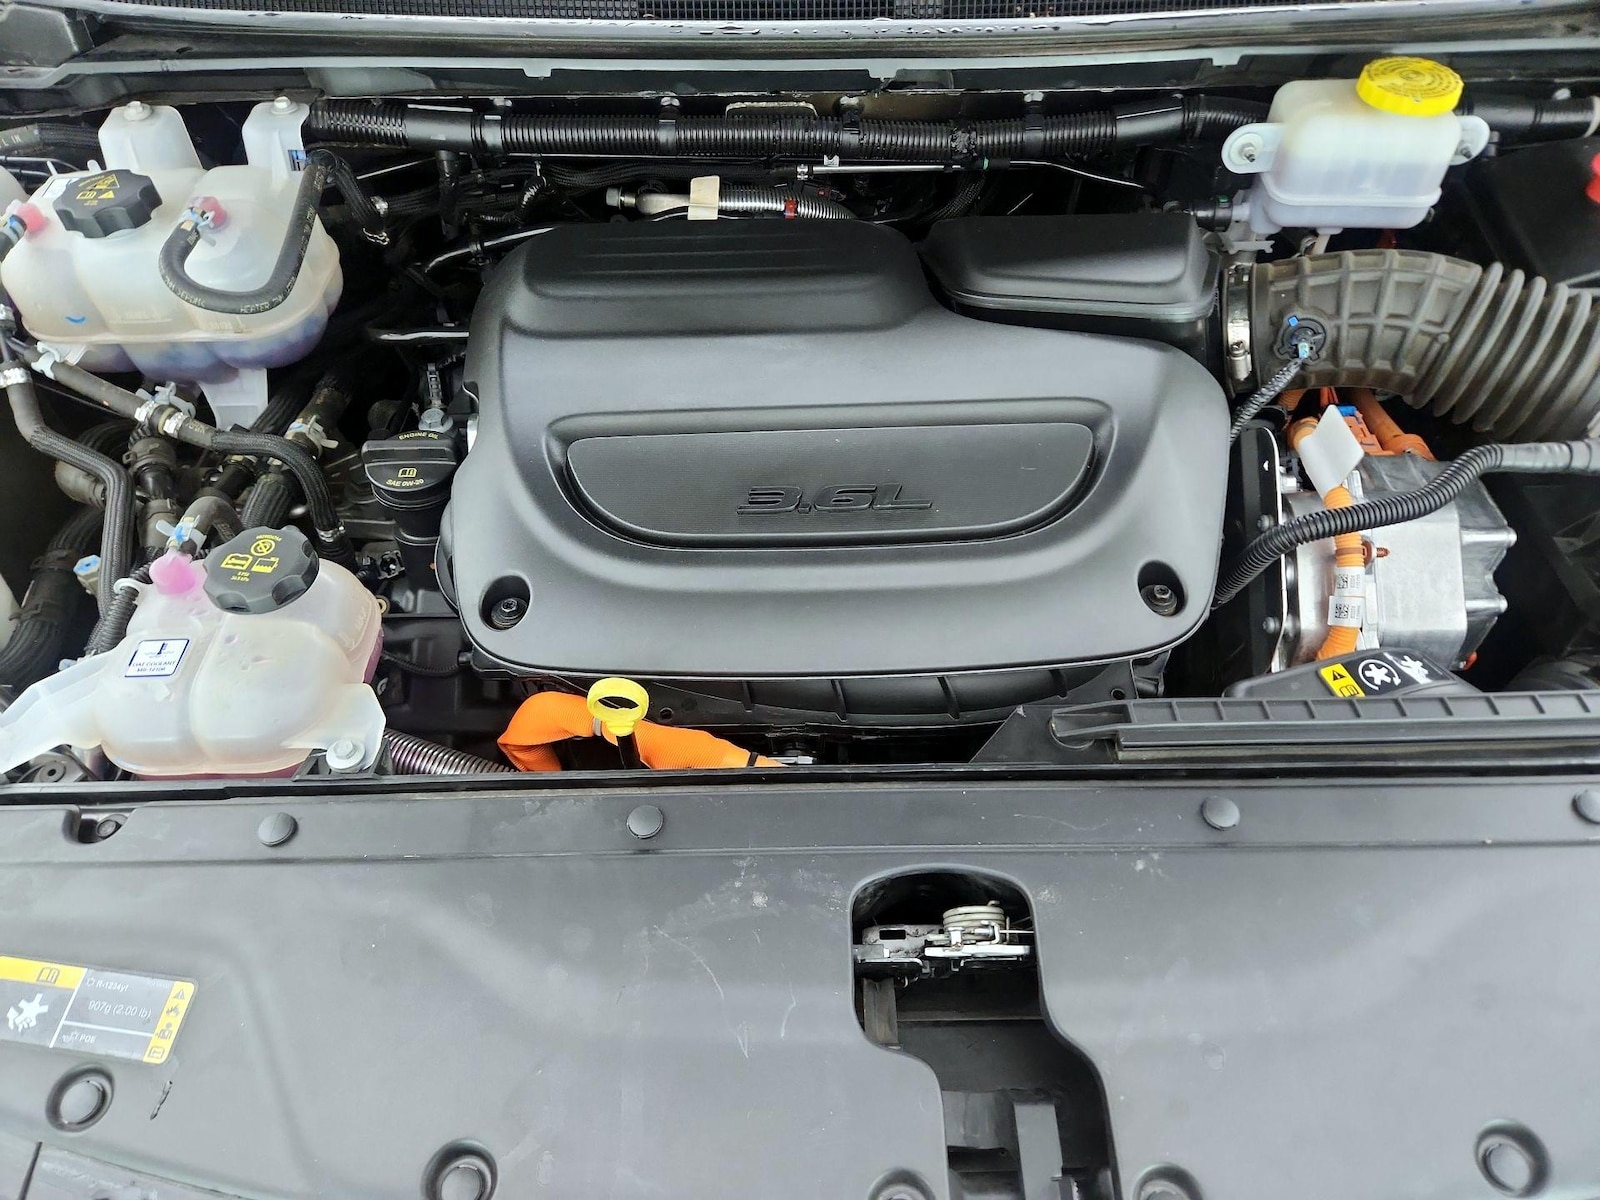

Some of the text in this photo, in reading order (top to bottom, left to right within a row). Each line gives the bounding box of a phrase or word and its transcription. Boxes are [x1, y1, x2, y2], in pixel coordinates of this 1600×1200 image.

[399, 431, 439, 440] ENGINE OIL
[737, 483, 932, 514] 3.6L
[88, 1000, 111, 1015] 907g
[138, 1007, 152, 1019] lb)
